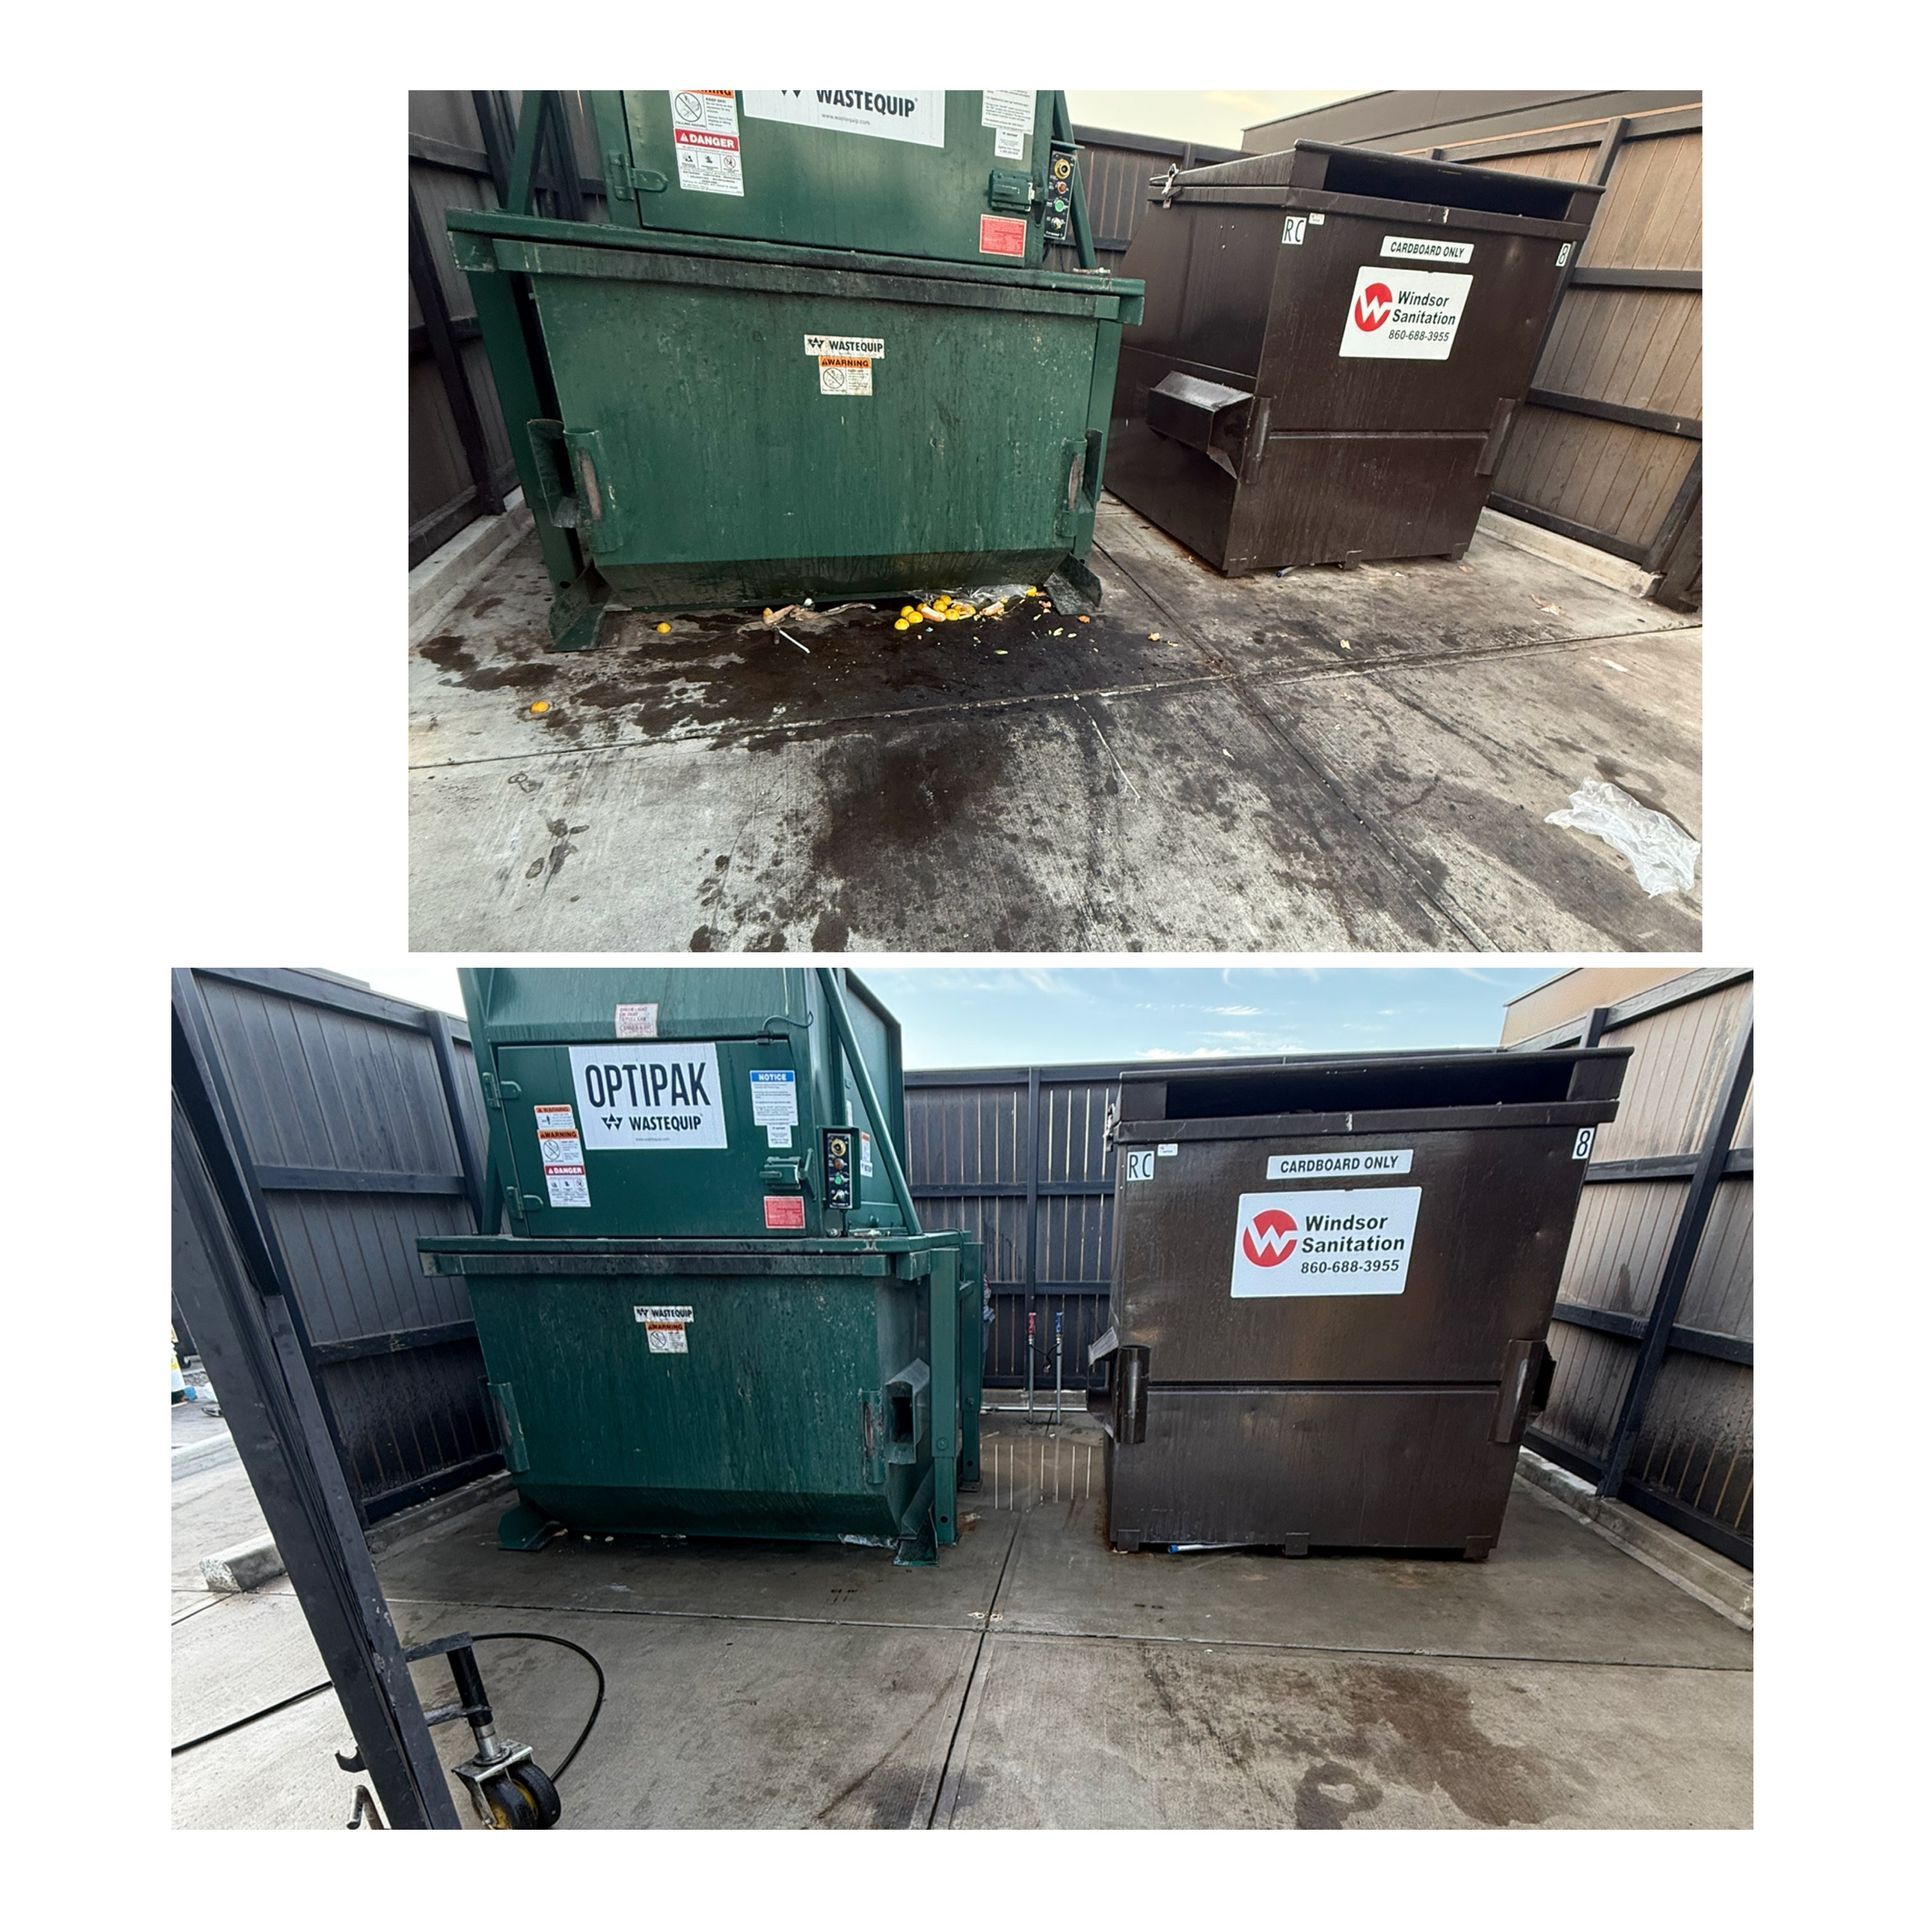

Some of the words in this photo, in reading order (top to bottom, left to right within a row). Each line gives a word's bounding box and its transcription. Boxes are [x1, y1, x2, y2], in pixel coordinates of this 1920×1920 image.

[816, 90, 915, 118] WASTEQUIP
[689, 133, 735, 149] DANGER
[1390, 240, 1441, 257] CARDBOARD
[1443, 246, 1465, 259] ONLY
[1558, 245, 1568, 264] 8
[1397, 290, 1449, 307] Windsor
[1392, 309, 1456, 326] Sanitation
[1388, 329, 1450, 342] 860-688-3955
[828, 340, 883, 352] WASTEQUIP
[827, 359, 869, 367] WARNING
[585, 1062, 711, 1108] OPTIPAK
[758, 1073, 787, 1081] NOTICE
[628, 1115, 702, 1132] WASTEQUIP
[546, 1131, 578, 1139] WARNING
[1575, 1131, 1590, 1156] 8
[1280, 1156, 1360, 1173] CARDBOARD
[1363, 1154, 1398, 1170] ONLY
[1305, 1214, 1388, 1232] Windsor
[1301, 1235, 1405, 1254] Sanitation
[1300, 1259, 1400, 1275] 860-688-3955
[651, 1309, 692, 1317] WASTEQUIP
